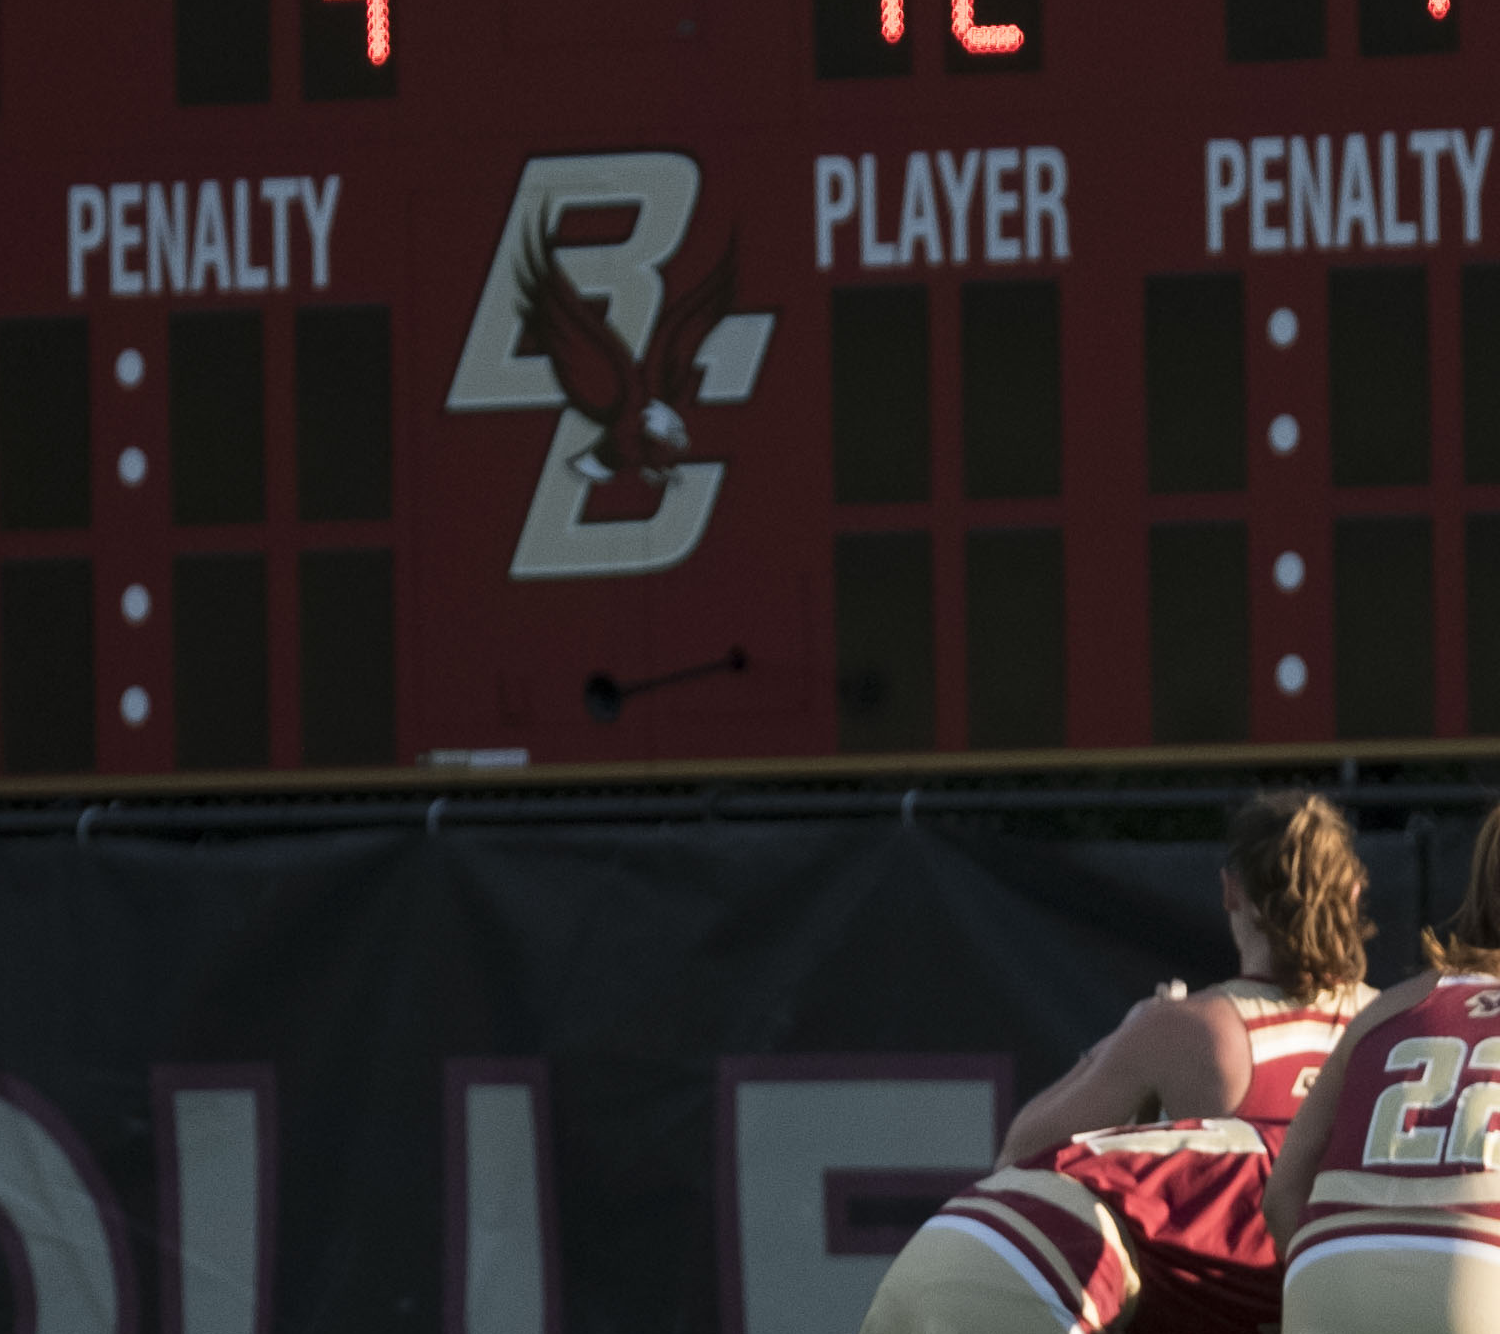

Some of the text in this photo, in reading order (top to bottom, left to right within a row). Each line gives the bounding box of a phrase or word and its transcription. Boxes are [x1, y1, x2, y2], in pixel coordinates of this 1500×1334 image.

[67, 174, 341, 299] PENALTY
[814, 146, 1071, 270] PLAYER
[1205, 127, 1494, 254] PENALTY
